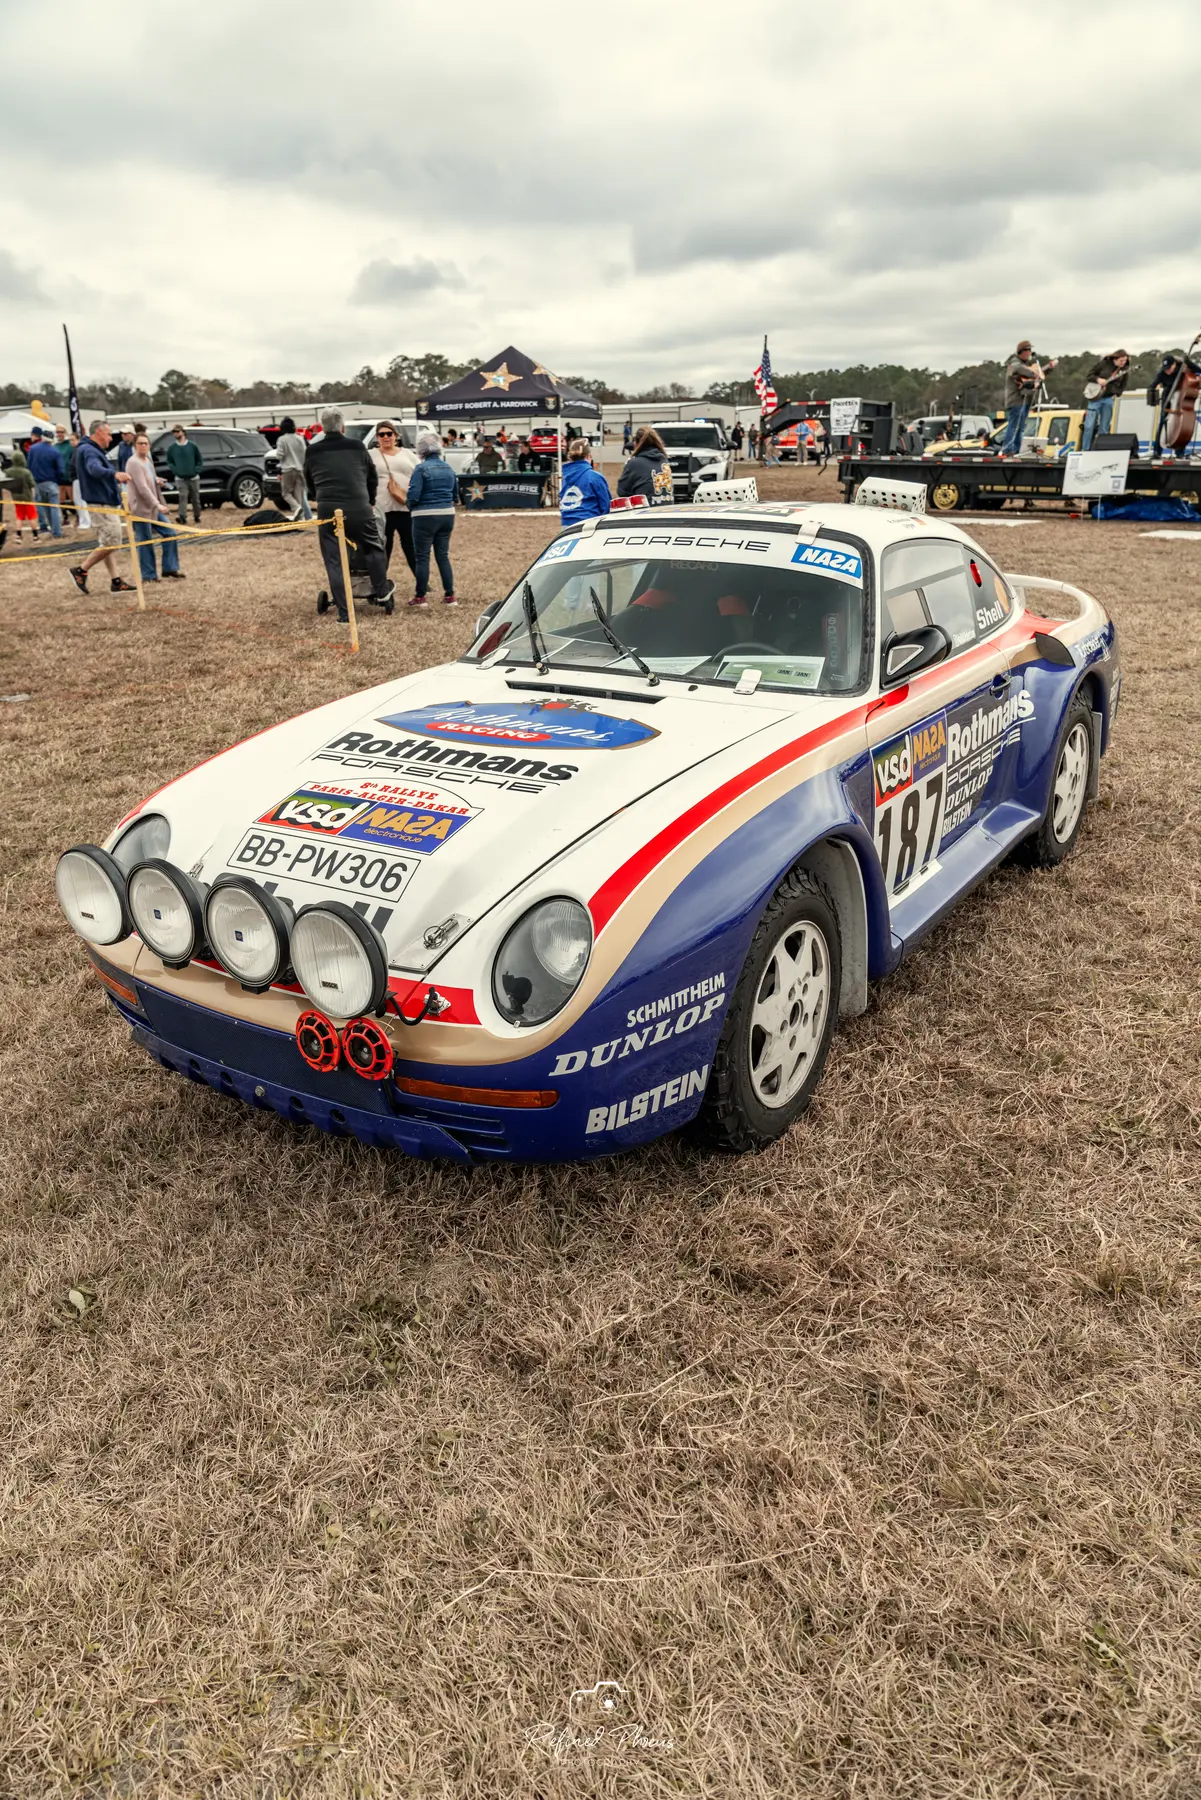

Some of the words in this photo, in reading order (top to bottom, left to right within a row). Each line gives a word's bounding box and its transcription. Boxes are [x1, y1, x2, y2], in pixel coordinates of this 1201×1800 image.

[500, 400, 538, 408] HARDWICK
[519, 485, 538, 493] OFFICE
[603, 536, 771, 553] PORSCHE
[799, 548, 858, 573] NASA
[670, 560, 720, 571] RECARO
[976, 600, 1004, 630] Shell
[413, 708, 614, 742] Rothmans
[438, 723, 538, 739] RACING
[913, 721, 946, 765] NASA
[950, 689, 1035, 766] Rothmans
[311, 753, 551, 794] PORSCHE
[326, 732, 579, 782] Rothmans
[877, 735, 911, 792] vsd
[947, 728, 1020, 793] PORSCHE
[309, 784, 470, 815] PARIS-ALGER-DAKAR
[380, 785, 439, 800] RALLYE
[944, 765, 993, 815] DUNLOP
[279, 800, 364, 829] vsd
[355, 807, 453, 839] NASA
[878, 772, 944, 894] 187
[942, 799, 972, 838] BILSTEIN
[236, 834, 408, 893] BB-PW306
[627, 972, 725, 1028] SCHMITTHELM
[548, 993, 725, 1077] DUNLOP
[585, 1063, 709, 1134] BILSTEIN
